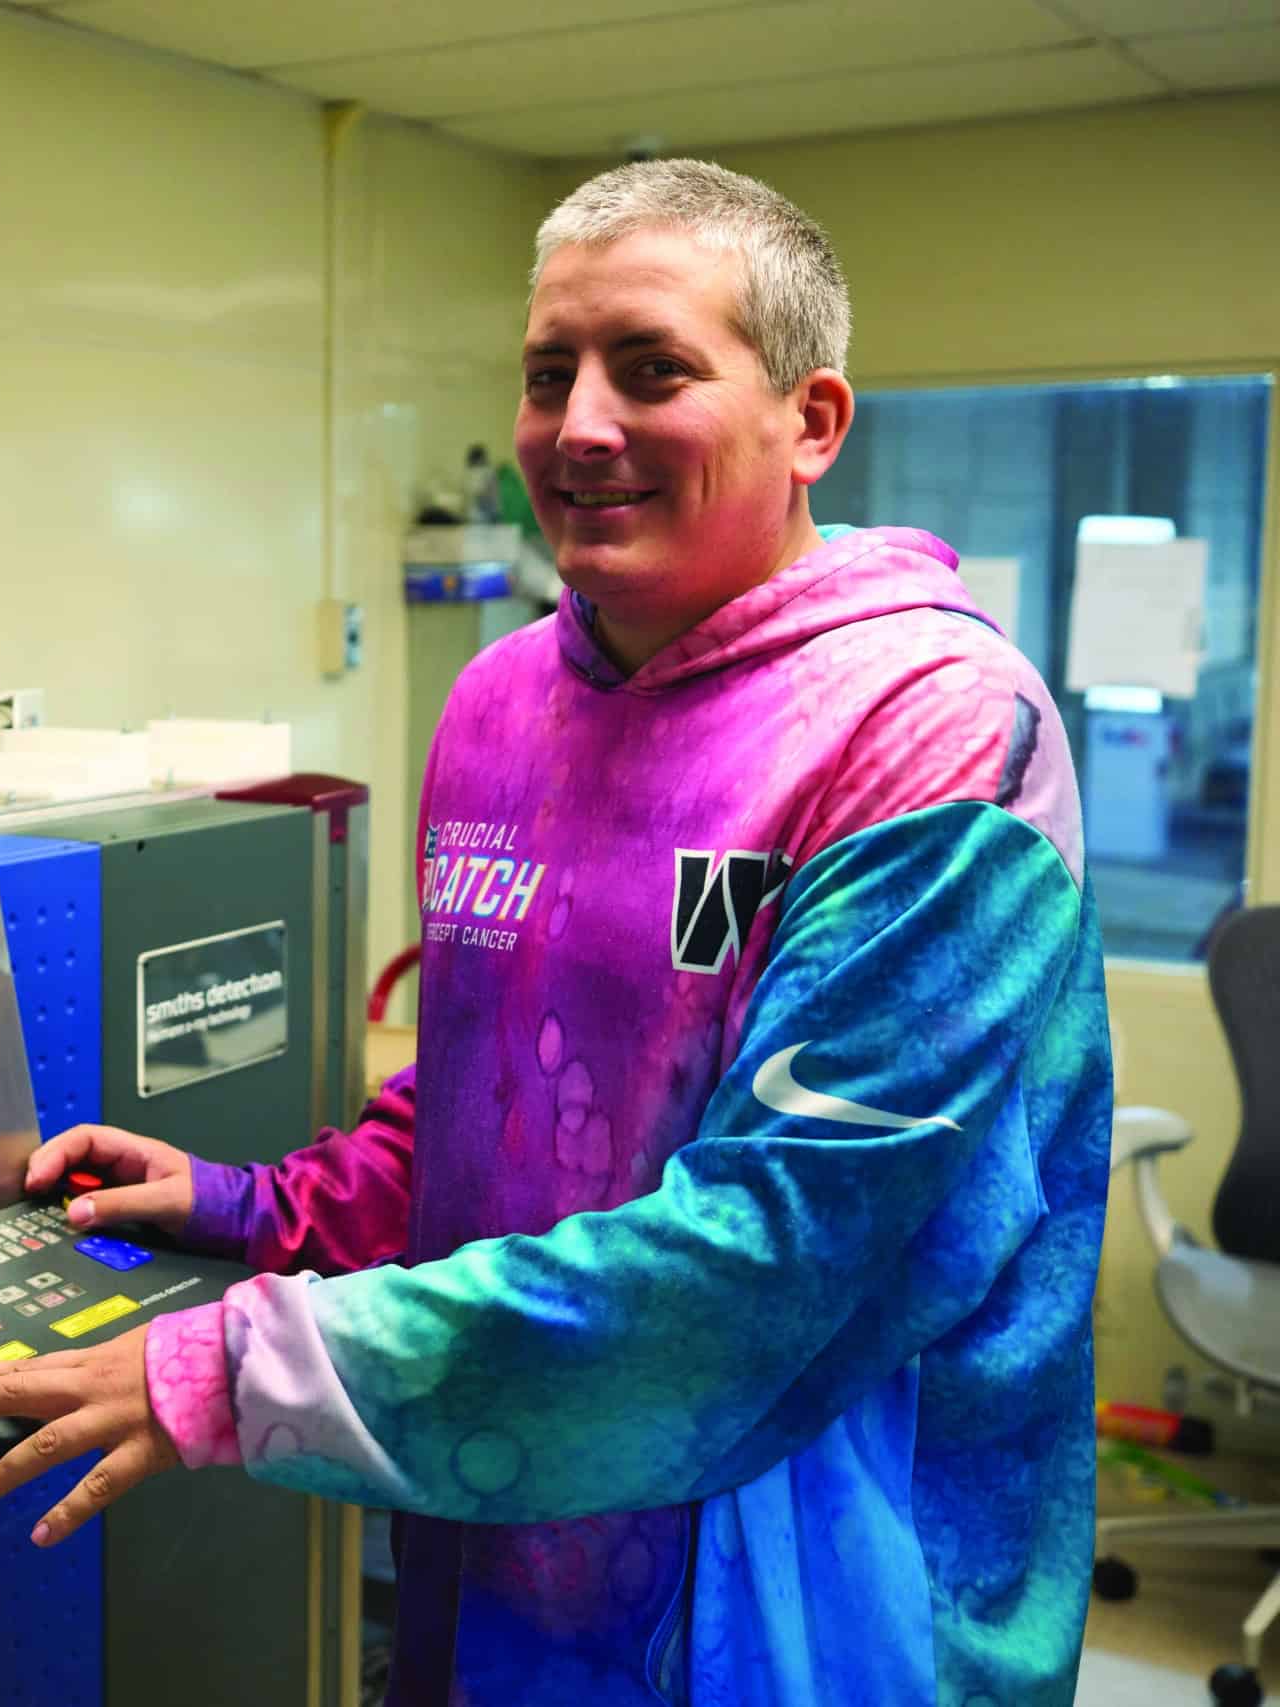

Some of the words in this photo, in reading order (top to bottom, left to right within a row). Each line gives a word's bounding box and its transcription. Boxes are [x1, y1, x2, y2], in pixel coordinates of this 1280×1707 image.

[440, 821, 518, 850] CRUCIAL
[430, 855, 546, 921] CATCH
[462, 925, 518, 952] CANCER
[146, 991, 205, 1024] smiths
